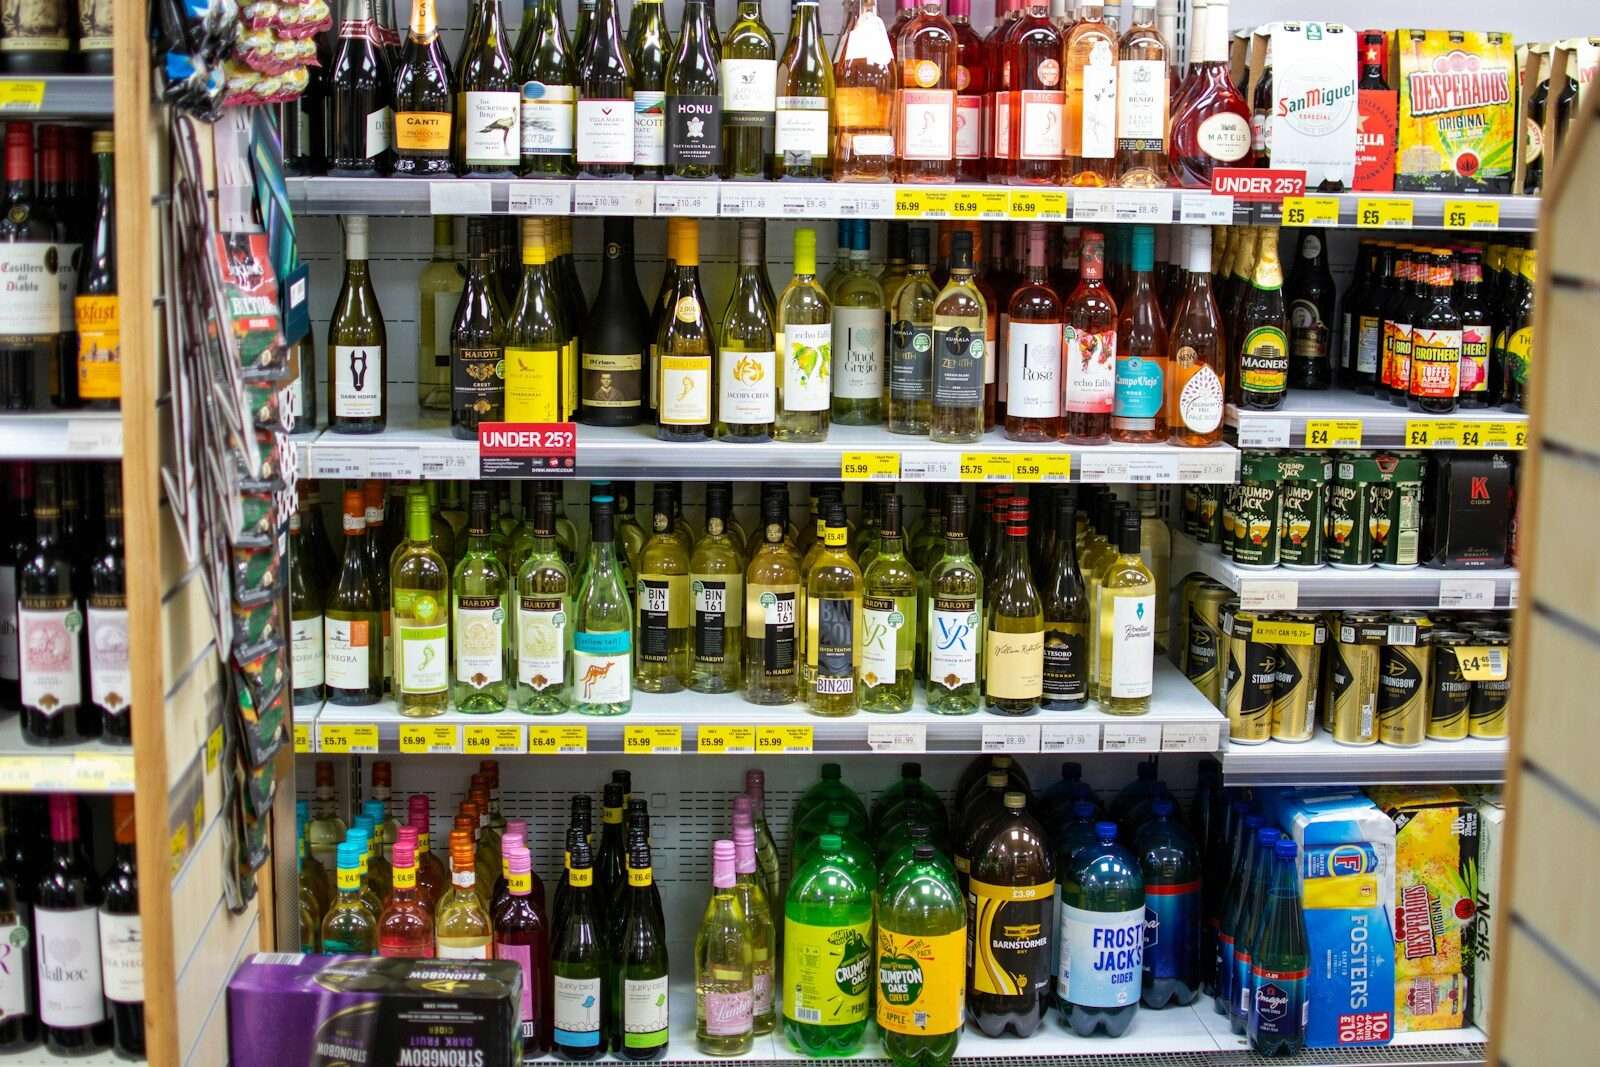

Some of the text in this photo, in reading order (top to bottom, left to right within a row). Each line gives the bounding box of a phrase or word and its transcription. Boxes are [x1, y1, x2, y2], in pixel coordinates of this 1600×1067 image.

[1411, 71, 1509, 113] DESPERADOS
[1277, 79, 1355, 117] San Miguel
[678, 104, 713, 114] HONU
[406, 117, 439, 125] CANTI
[1438, 113, 1487, 131] ORIGINAL
[1207, 133, 1247, 141] MATEUS
[1215, 177, 1303, 194] UNDER 25?
[896, 201, 919, 211] £6.99
[954, 202, 977, 212] £6.99
[1012, 203, 1036, 213] £6.99
[1288, 209, 1305, 224] £5
[1363, 210, 1380, 225] £5
[1450, 211, 1466, 227] £5
[464, 351, 498, 359] HARDYS
[847, 350, 875, 363] Pinot
[1415, 346, 1458, 361] BROTHERS
[844, 362, 877, 375] Grigio
[1241, 356, 1288, 370] MAGNERS
[1422, 365, 1450, 377] TOFFEE
[1073, 378, 1093, 387] echo
[1115, 375, 1137, 388] Campo
[1422, 375, 1450, 385] APPLE
[482, 431, 573, 447] UNDER 25?
[1311, 430, 1328, 445] £4
[1411, 431, 1428, 446] £4
[1463, 431, 1479, 447] £4
[845, 465, 868, 474] £5.99
[960, 465, 983, 474] £5.75
[1016, 466, 1039, 475] £5.99
[1472, 476, 1489, 499] K
[1237, 498, 1265, 513] JACK
[648, 589, 665, 599] BIN
[705, 589, 722, 599] BIN
[462, 599, 495, 607] HARDYS
[523, 601, 556, 609] HARDYS
[649, 600, 665, 610] 161
[705, 601, 722, 611] 161
[777, 602, 793, 612] BIN
[938, 601, 971, 609] HARDYS
[777, 613, 793, 623] 161
[324, 736, 347, 746] £5.75
[403, 736, 426, 745] £6.99
[467, 737, 490, 747] £6.49
[533, 737, 555, 747] £6.49
[627, 738, 650, 746] £5.99
[701, 738, 724, 746] £5.99
[759, 738, 782, 746] £5.99
[1405, 884, 1435, 958] DESPERADOS
[1430, 897, 1445, 936] ORIGINAL
[1476, 890, 1490, 962] INCH'S
[992, 937, 1047, 950] BARNSTORMER
[1093, 947, 1142, 971] JACK'S
[1351, 915, 1368, 1010] FOSTER'S
[409, 971, 486, 980] STRONGBOW
[1111, 972, 1133, 984] CIDER
[888, 983, 908, 993] OAKS
[1256, 990, 1288, 1009] Omega
[886, 1012, 905, 1023] APPLE
[1340, 1016, 1356, 1042] £10
[1356, 1015, 1364, 1041] CANS
[1372, 1014, 1388, 1039] 10x
[410, 1036, 473, 1046] DARK FRUIT
[317, 1042, 367, 1064] STRONGBOW
[400, 1050, 484, 1067] STRONGBOW
